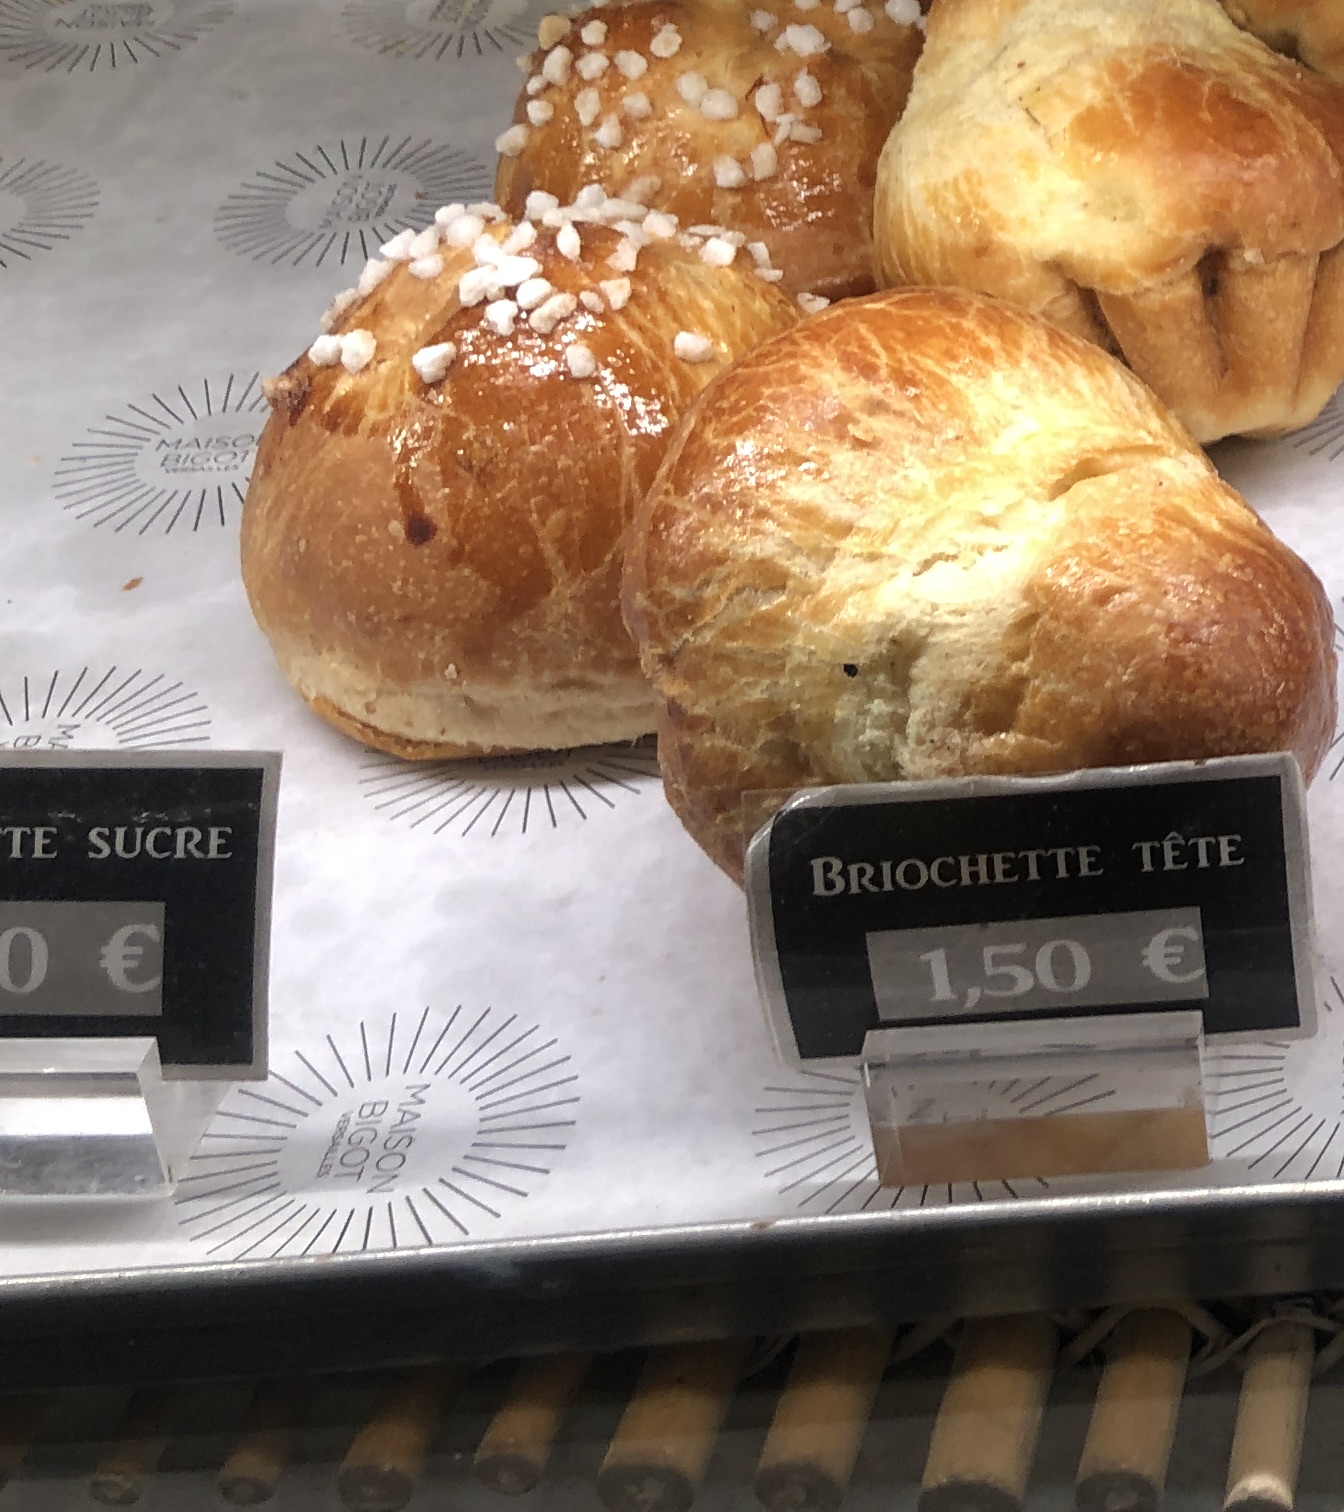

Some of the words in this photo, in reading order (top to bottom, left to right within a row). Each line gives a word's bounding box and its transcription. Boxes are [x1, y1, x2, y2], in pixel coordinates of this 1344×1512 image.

[156, 433, 257, 451] MAISO
[0, 826, 58, 859] TE
[88, 826, 234, 860] SUCRE
[810, 844, 1104, 897] BRIOCHETTE
[1131, 831, 1246, 871] TÊTE
[99, 922, 162, 995] €
[918, 939, 1093, 1009] 1,50
[1140, 925, 1204, 983] €
[333, 1100, 390, 1182] BIGOT
[365, 1083, 432, 1194] MAISON
